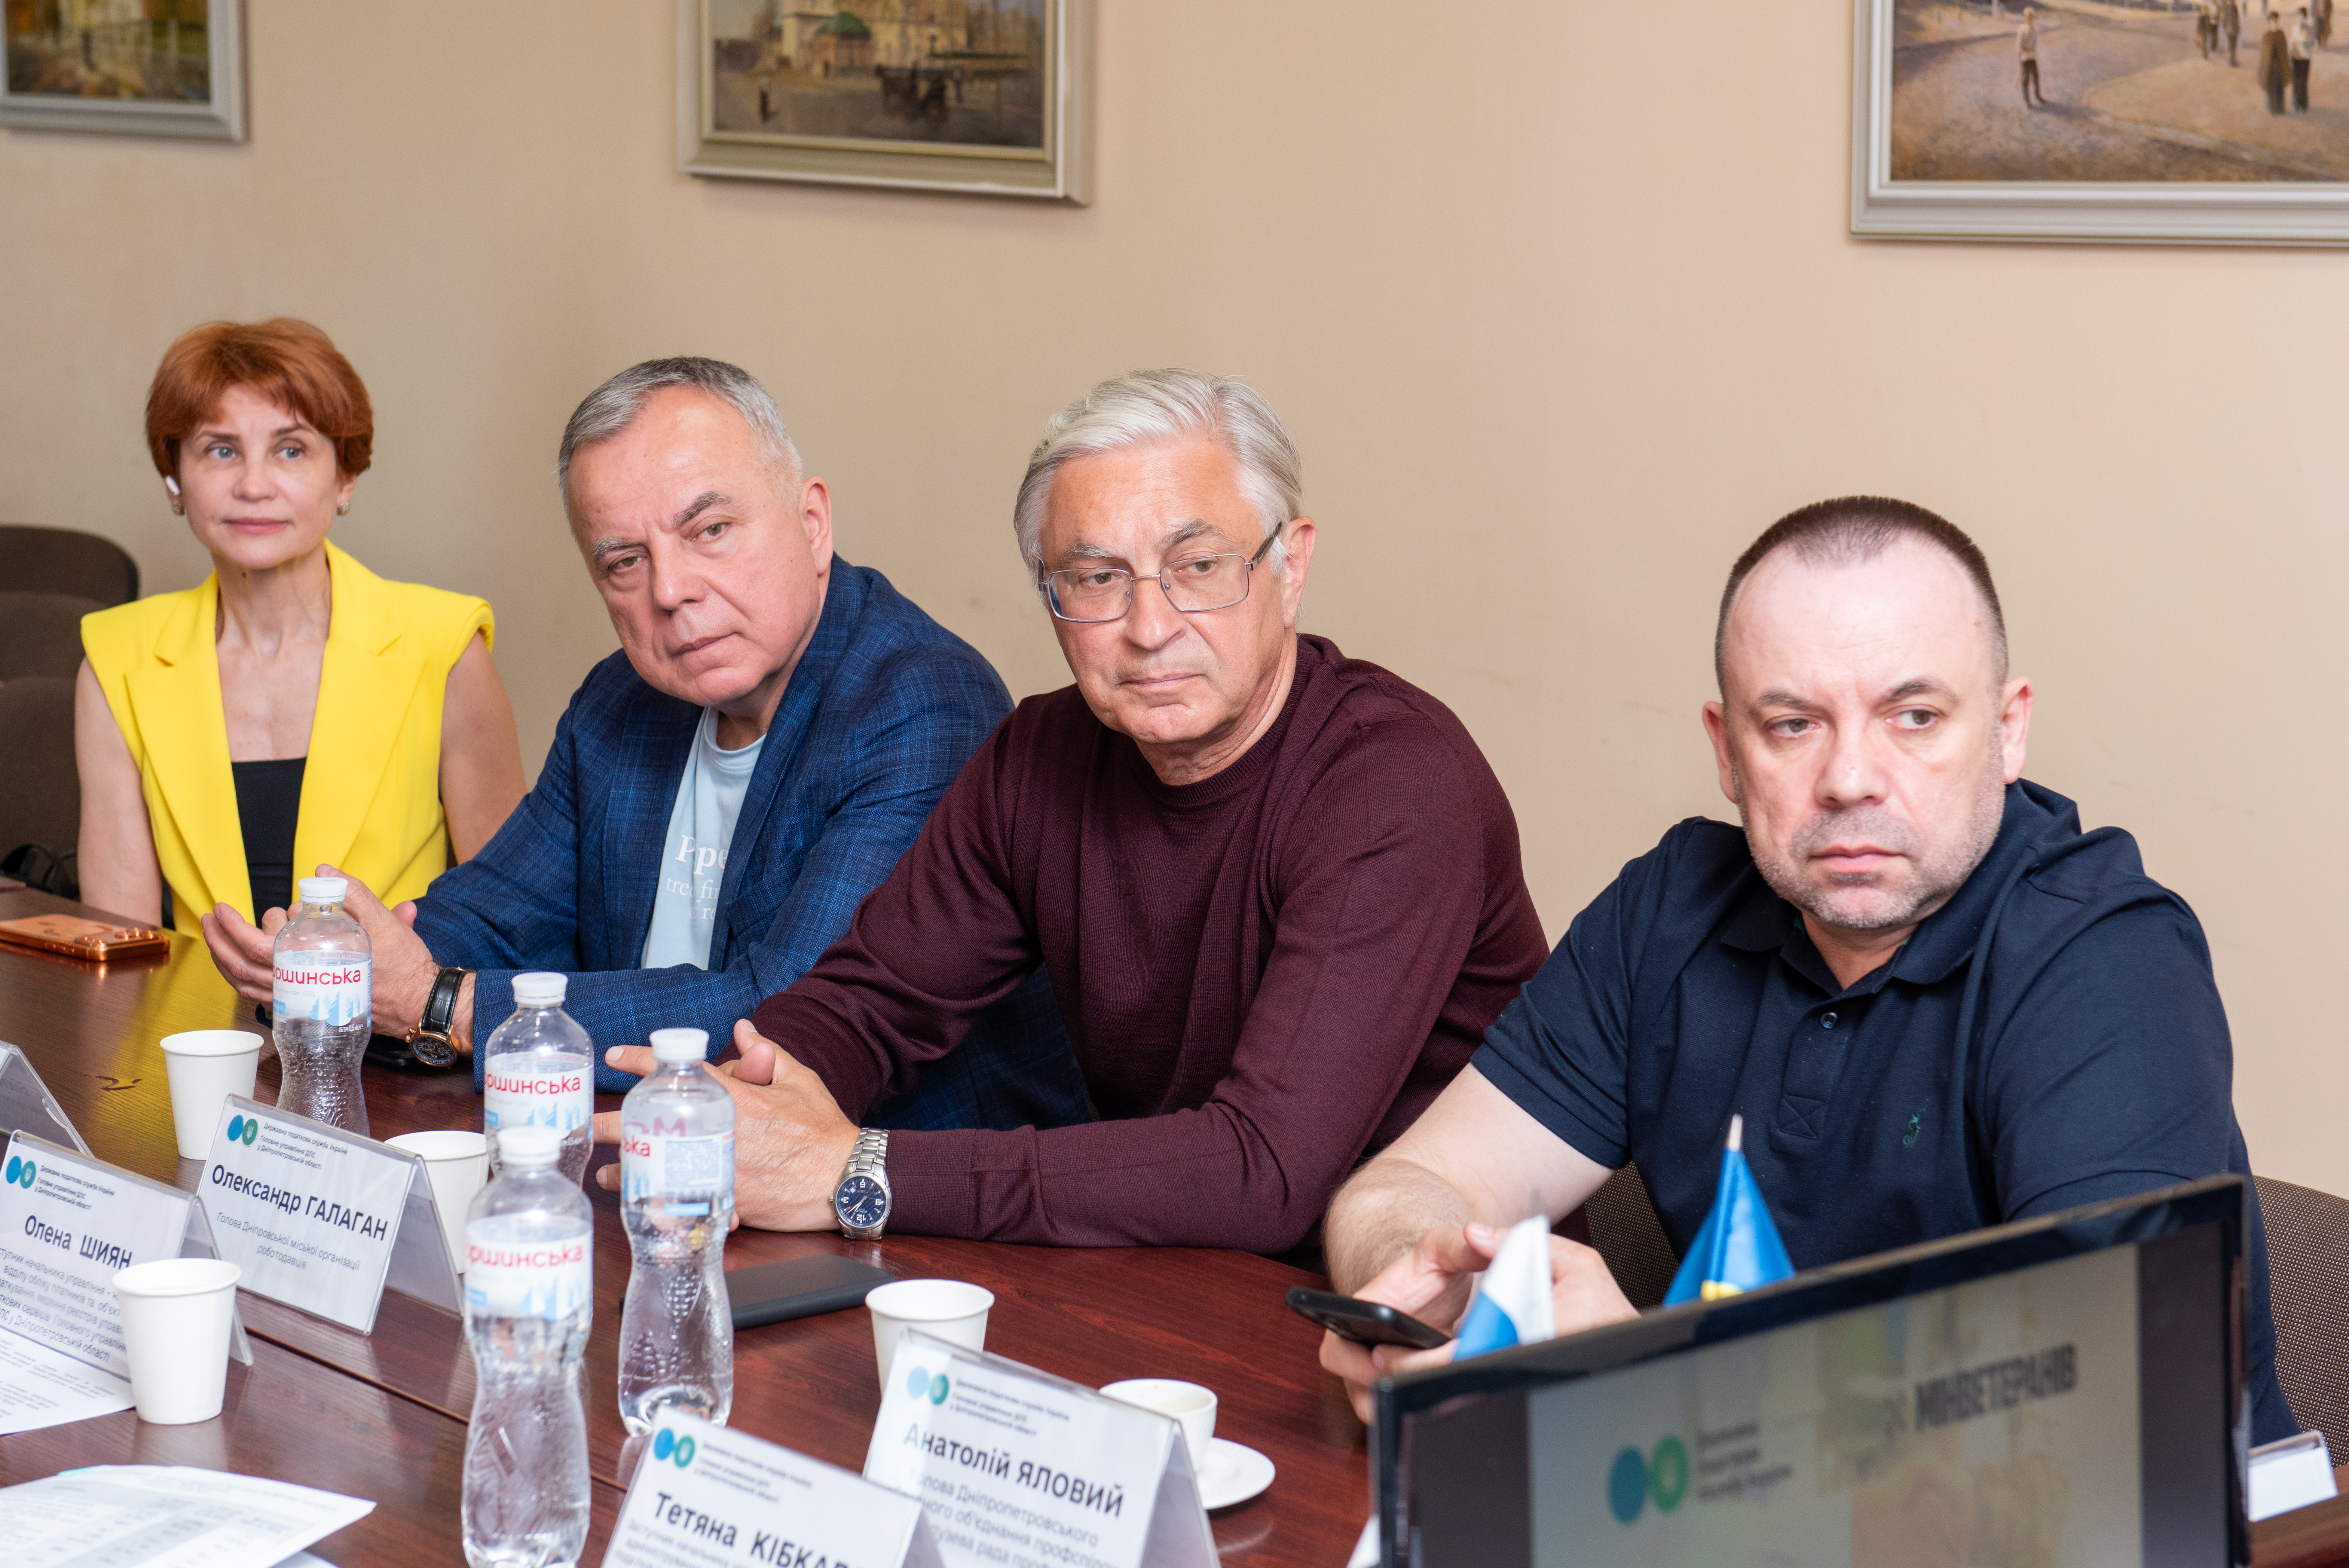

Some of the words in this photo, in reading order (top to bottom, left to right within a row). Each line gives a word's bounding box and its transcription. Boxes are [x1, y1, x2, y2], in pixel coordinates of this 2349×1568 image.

[273, 965, 361, 985] оршинська
[260, 1135, 279, 1146] Головне
[280, 1142, 305, 1155] управління
[305, 1150, 316, 1158] ДПС
[261, 1144, 304, 1164] Дніпропетровській
[305, 1159, 322, 1170] області
[263, 1123, 287, 1135] Державна
[288, 1131, 311, 1143] податкова
[312, 1138, 328, 1149] служба
[329, 1143, 348, 1155] України
[212, 1164, 302, 1215] Олександр
[305, 1196, 389, 1241] ГАЛАГАН
[25, 1215, 71, 1250] Олена
[79, 1235, 132, 1270] ШИЯН
[217, 1212, 241, 1228] Голова
[242, 1221, 290, 1245] Дніпровської
[290, 1239, 319, 1256] міської
[318, 1249, 361, 1271] організації
[257, 1245, 306, 1269] роботодавців
[0, 1248, 25, 1264] тупник
[25, 1257, 65, 1280] начальника
[64, 1273, 105, 1293] управління
[0, 1278, 35, 1301] аткування,
[4, 1264, 28, 1283] відділу
[14, 1315, 82, 1350] Дніпропетровській
[82, 1344, 111, 1361] області
[903, 1422, 1011, 1480] Анатолій
[1016, 1460, 1124, 1517] ЯЛОВИЙ
[654, 1491, 738, 1548] Тетяна
